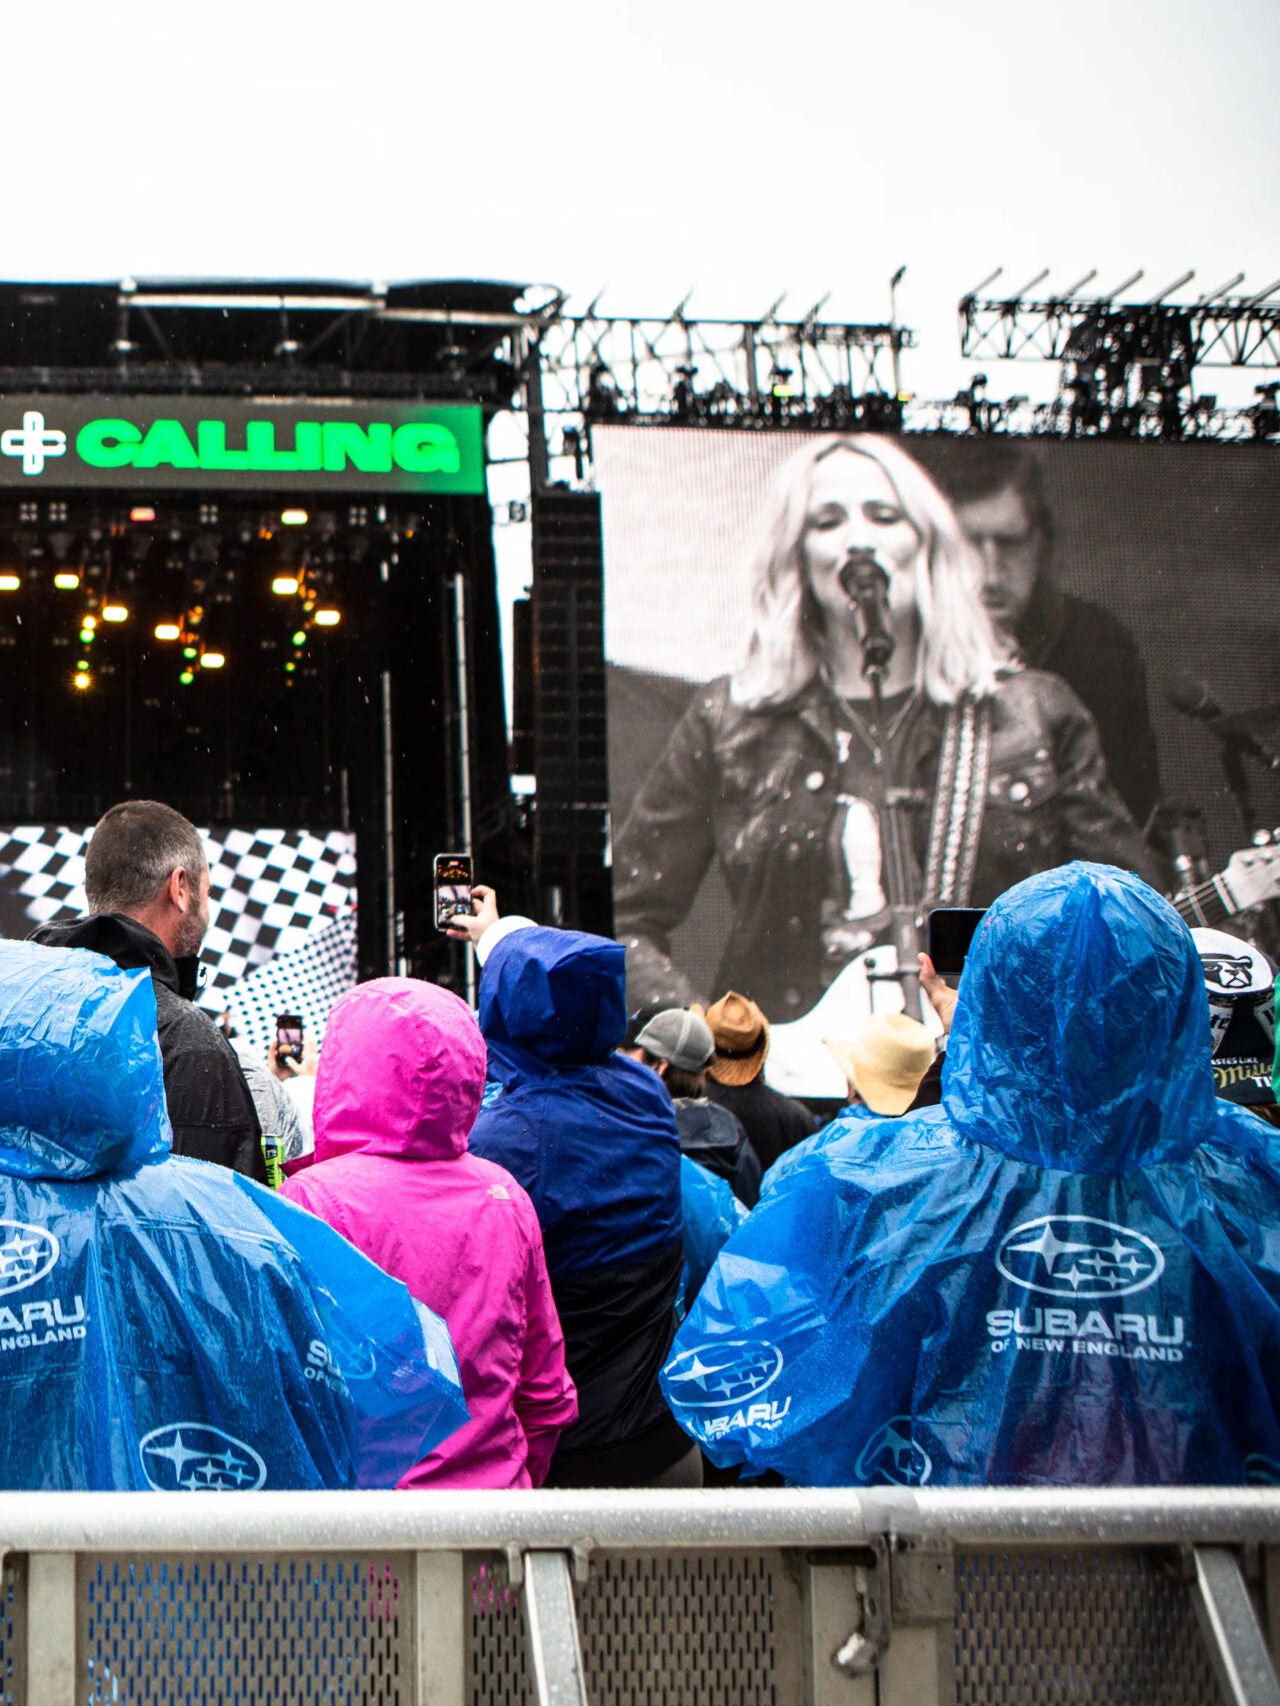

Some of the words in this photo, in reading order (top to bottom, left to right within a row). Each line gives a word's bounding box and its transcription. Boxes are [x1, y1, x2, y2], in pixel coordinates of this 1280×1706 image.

[76, 418, 461, 474] CALLING
[1213, 1063, 1273, 1089] Mille
[986, 1307, 1184, 1345] SUBARU
[991, 1338, 1010, 1353] OF
[1016, 1337, 1065, 1353] NEW
[1072, 1340, 1184, 1362] ENGLAND
